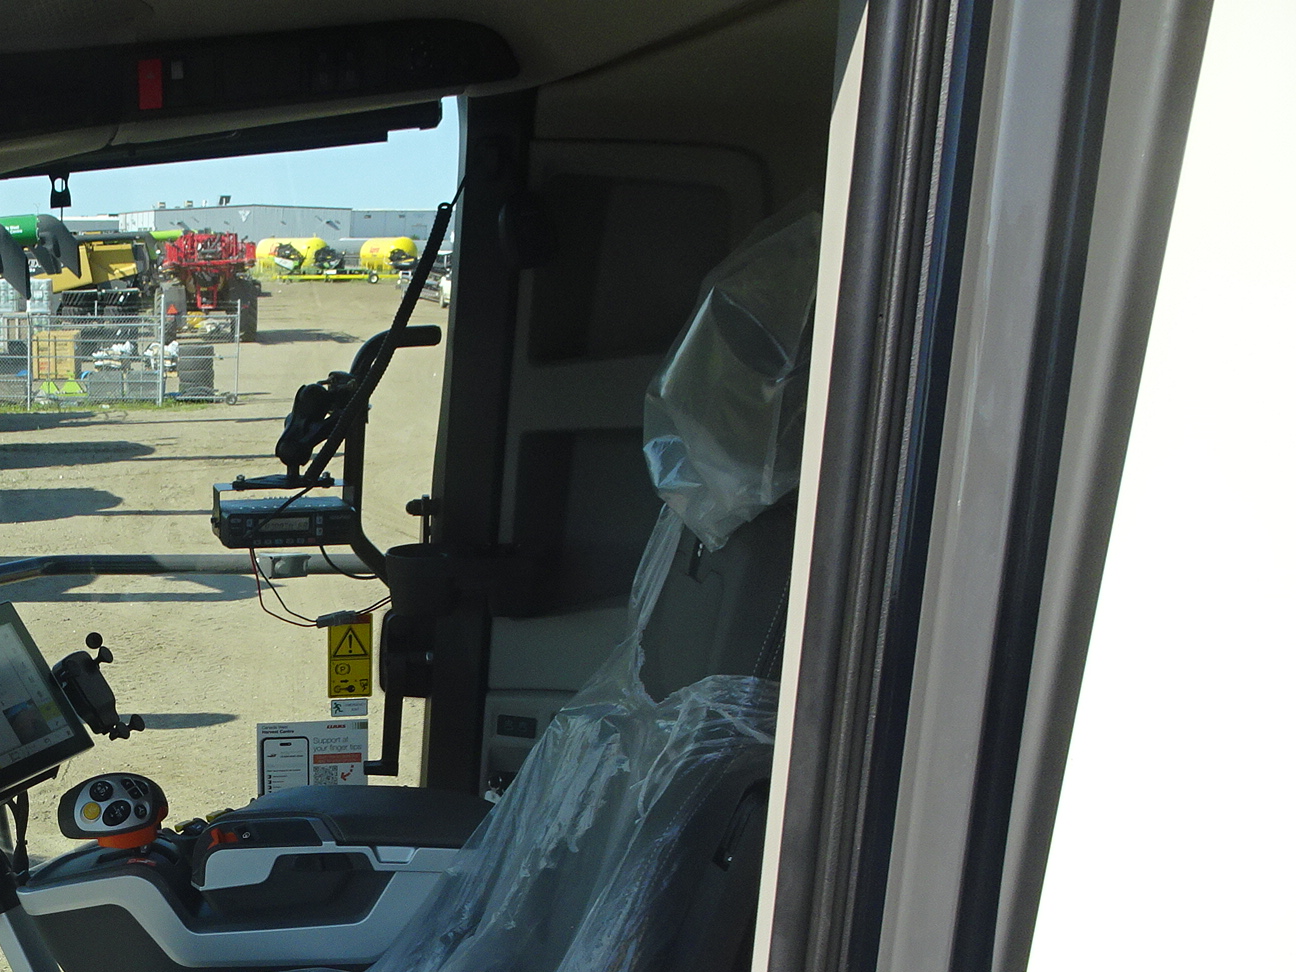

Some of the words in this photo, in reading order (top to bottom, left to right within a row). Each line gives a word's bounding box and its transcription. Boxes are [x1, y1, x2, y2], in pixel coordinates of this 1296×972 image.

[313, 736, 341, 745] Support
[329, 744, 348, 753] finger
[350, 744, 362, 752] tips
